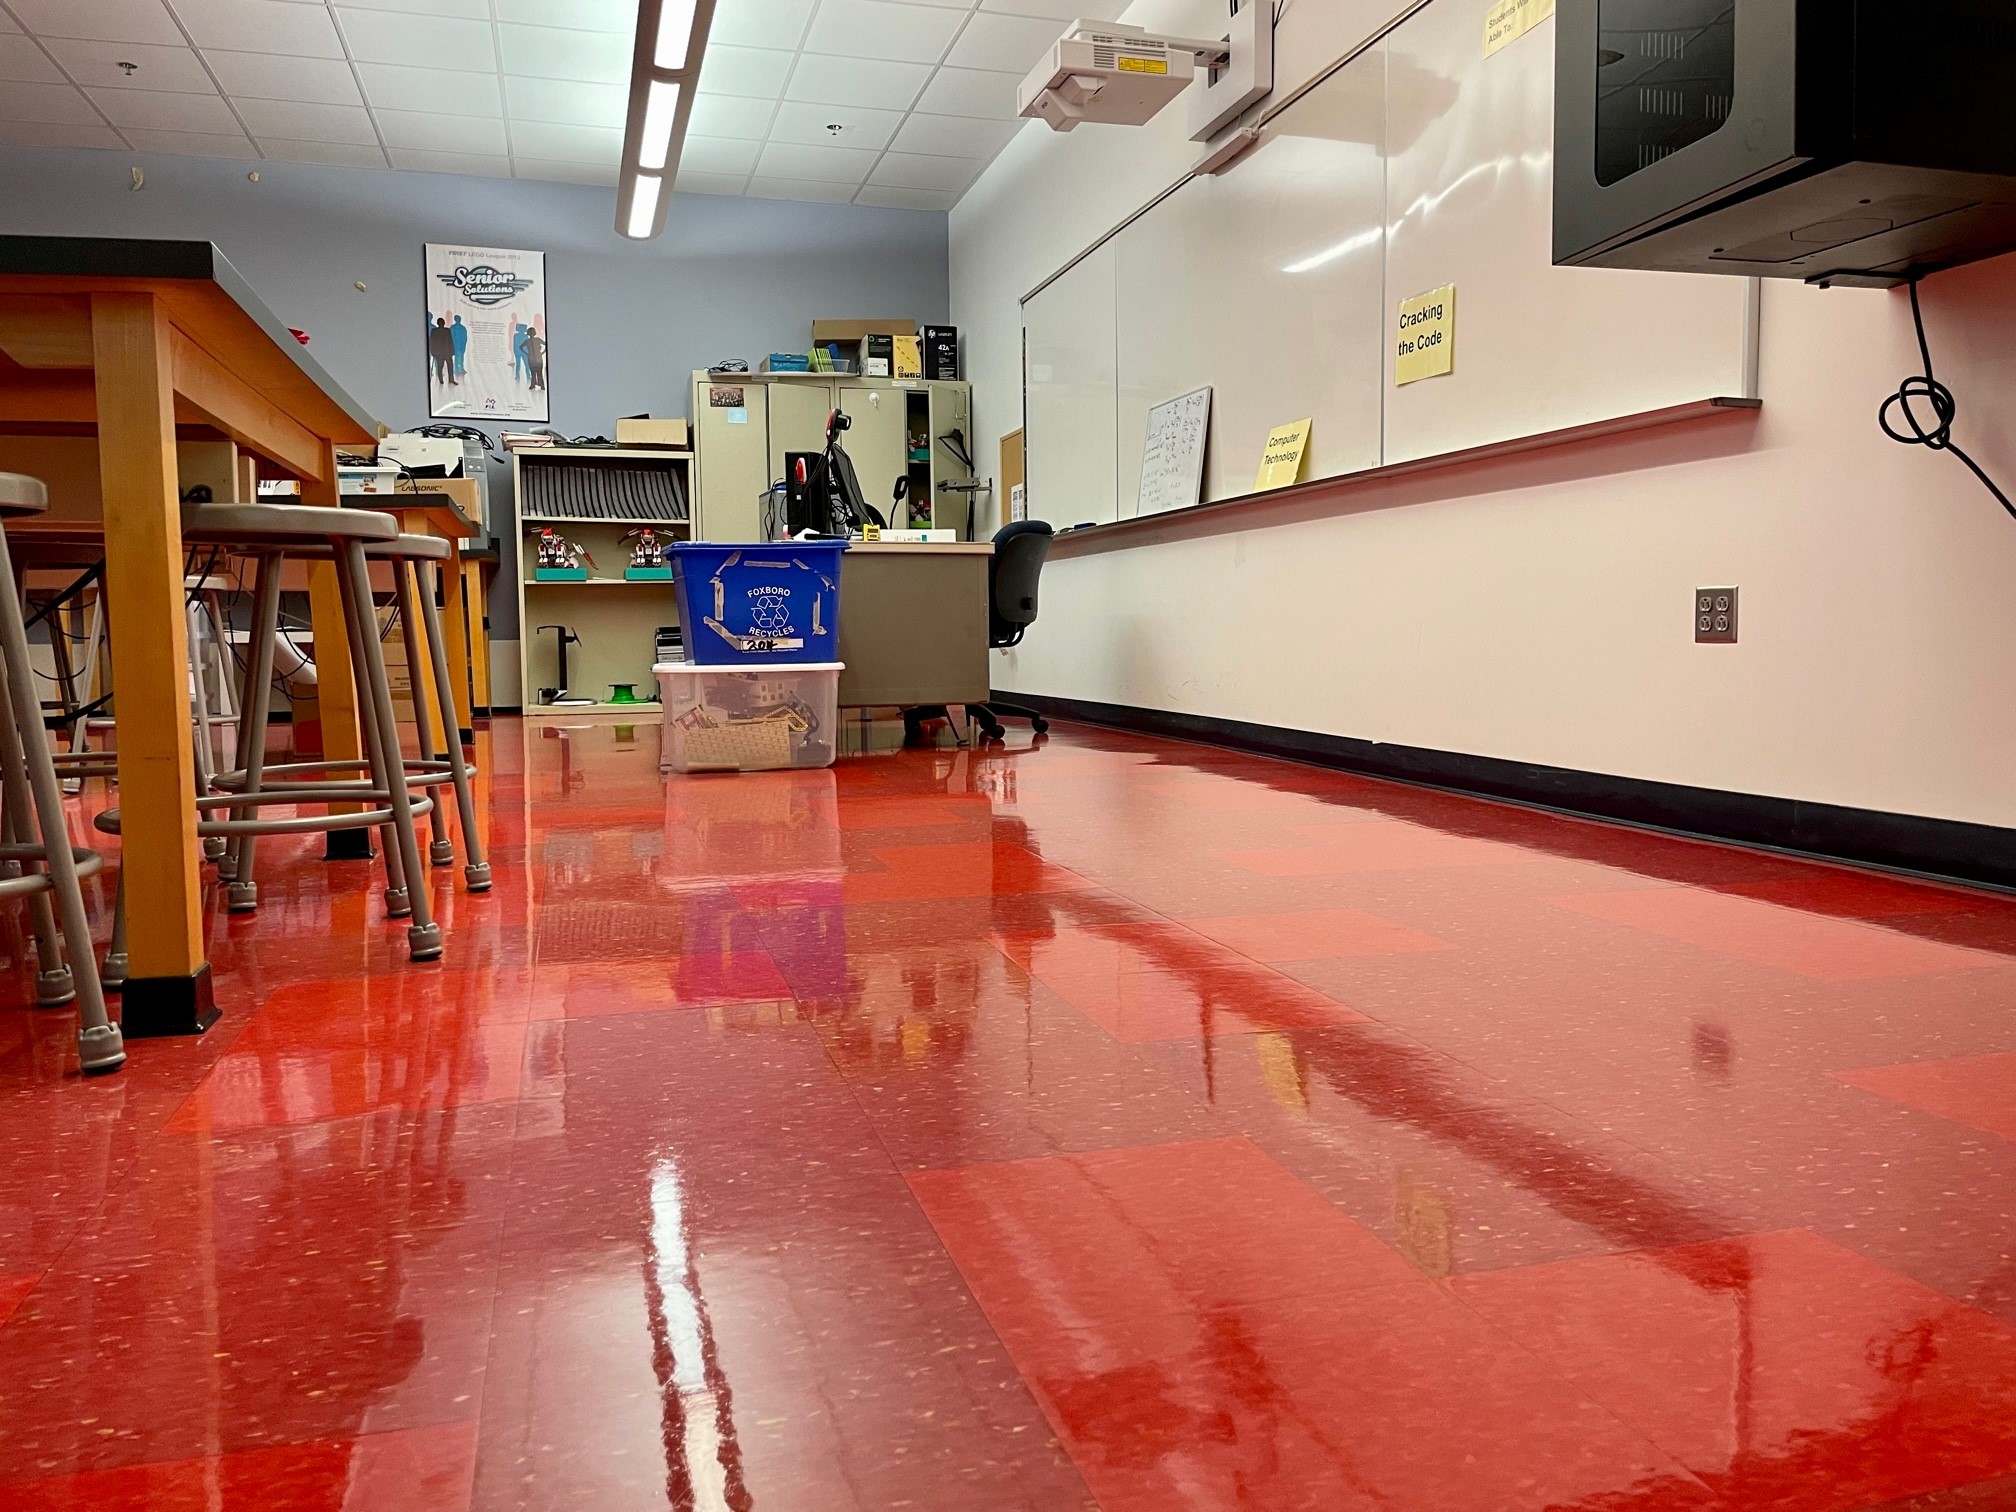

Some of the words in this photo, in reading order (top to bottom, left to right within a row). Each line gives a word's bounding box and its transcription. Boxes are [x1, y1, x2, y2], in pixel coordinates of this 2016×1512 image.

[1488, 6, 1516, 29] Students
[1488, 29, 1502, 44] Able
[453, 267, 515, 288] Senior
[464, 284, 514, 295] Solutions
[1399, 303, 1443, 329] Cracking
[1398, 340, 1414, 357] the
[1417, 329, 1442, 350] Code
[1269, 433, 1300, 447] Computer
[1264, 450, 1300, 465] Technology
[747, 586, 791, 598] FOXBORO
[748, 625, 795, 638] RECYCLES
